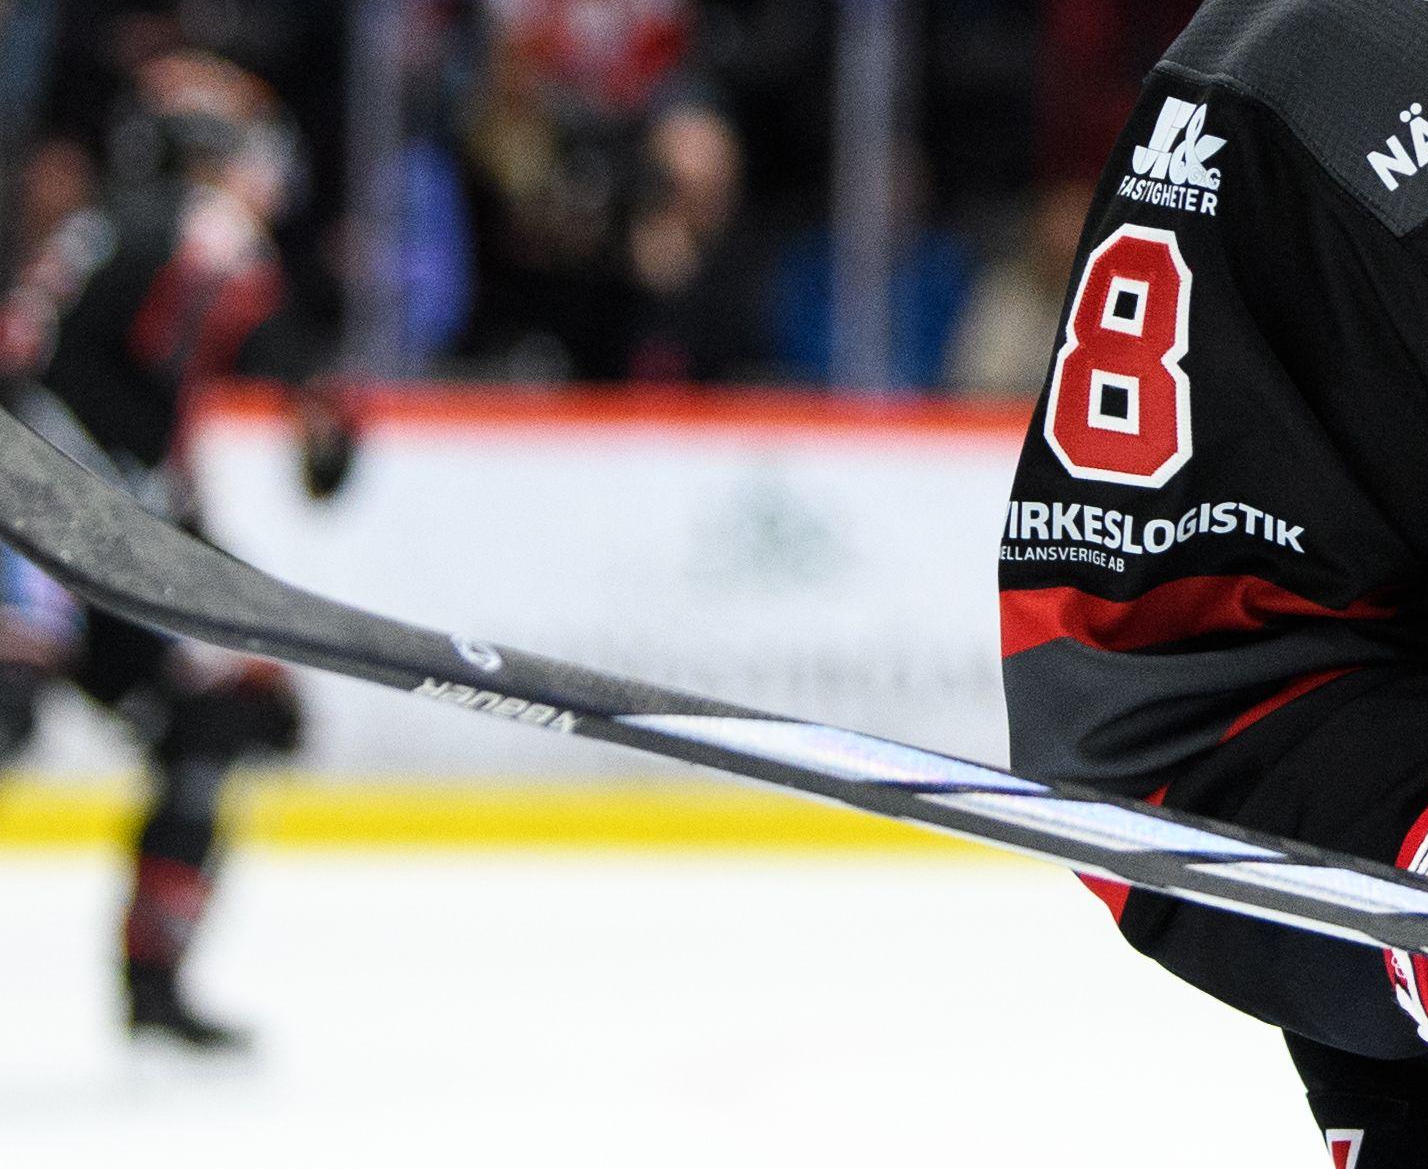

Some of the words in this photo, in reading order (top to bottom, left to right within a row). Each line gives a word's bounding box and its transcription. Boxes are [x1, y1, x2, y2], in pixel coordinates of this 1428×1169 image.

[1043, 222, 1193, 489] 8
[1000, 545, 1107, 567] ELLANSVERIGE
[1107, 555, 1126, 573] AB
